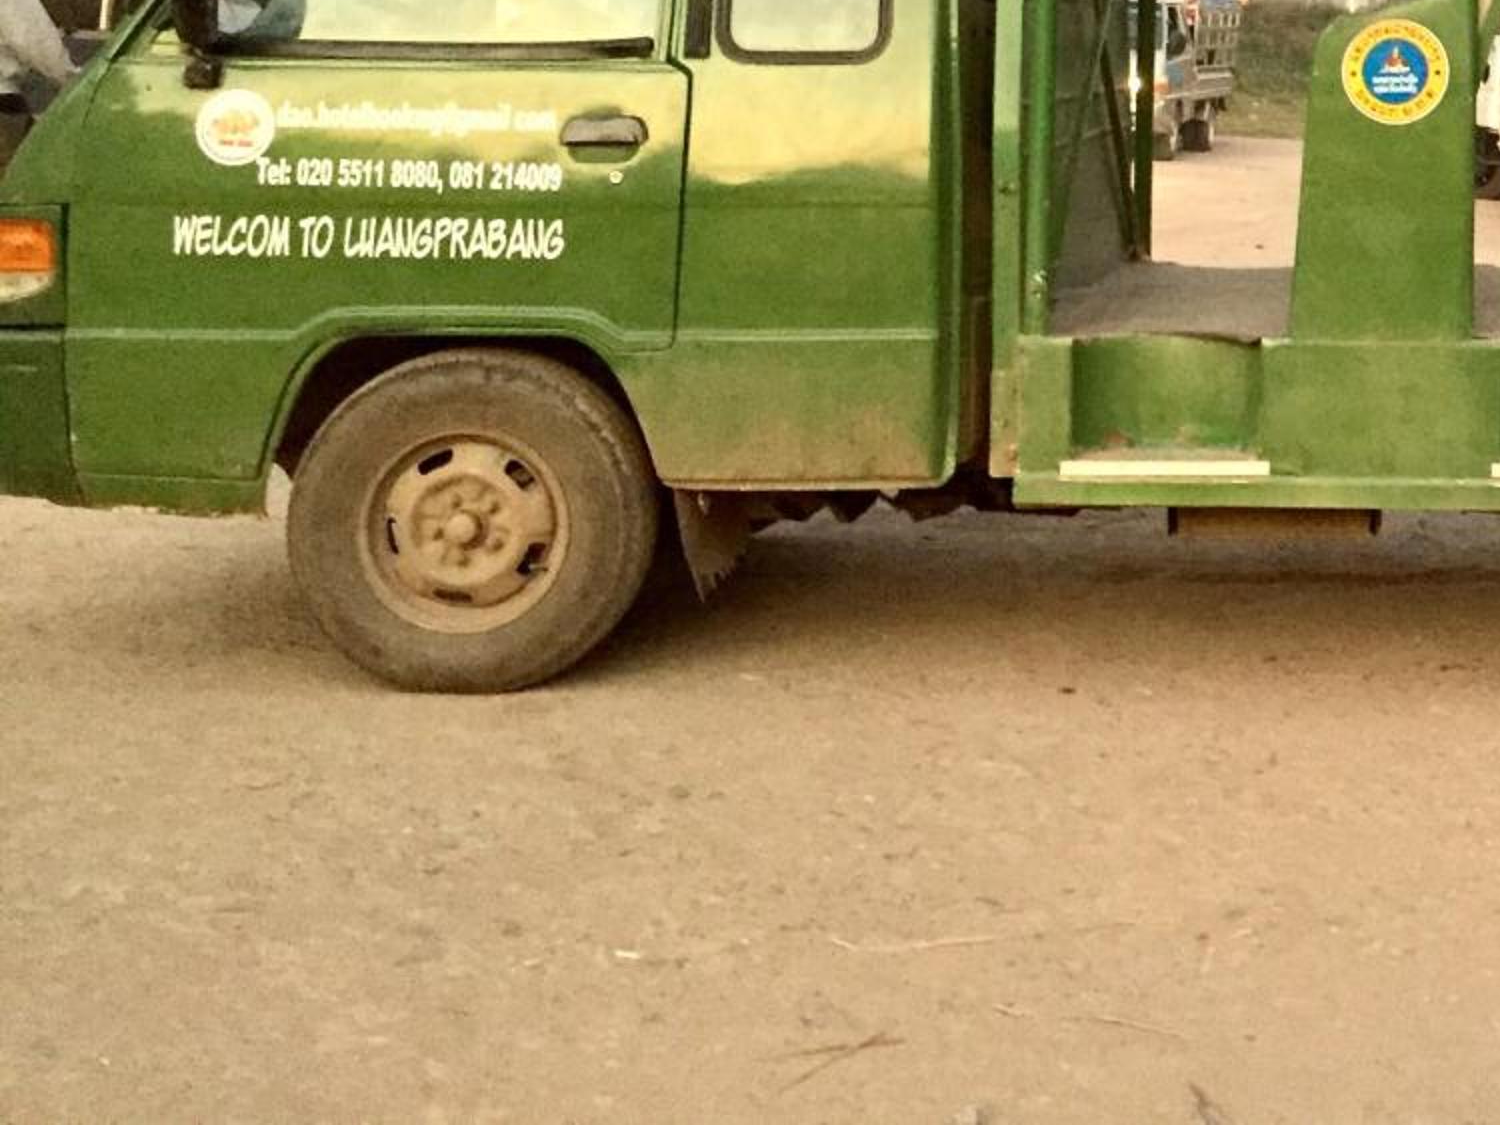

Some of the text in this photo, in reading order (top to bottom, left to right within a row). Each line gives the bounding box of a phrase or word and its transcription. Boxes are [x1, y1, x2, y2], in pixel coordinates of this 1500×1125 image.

[256, 157, 562, 195] Tel: 020 5511 8080, 081 214009
[173, 215, 566, 260] WELCOM TO LUANGPRABANG
